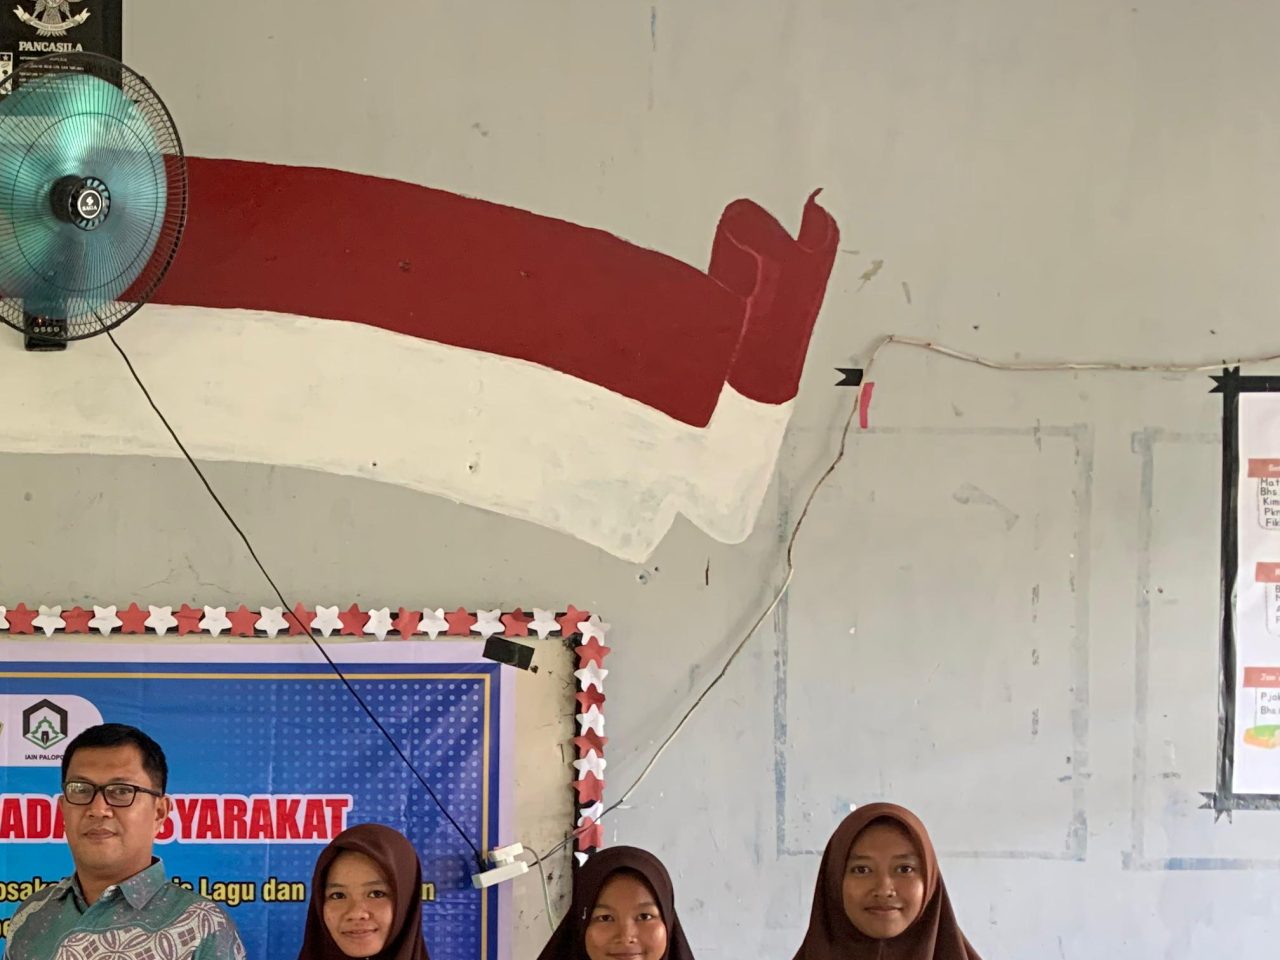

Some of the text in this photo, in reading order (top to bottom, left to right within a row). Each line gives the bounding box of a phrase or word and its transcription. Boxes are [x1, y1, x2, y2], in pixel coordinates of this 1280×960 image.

[19, 41, 83, 52] PANCASILA
[200, 879, 254, 905] Lagu
[263, 878, 304, 900] dan
